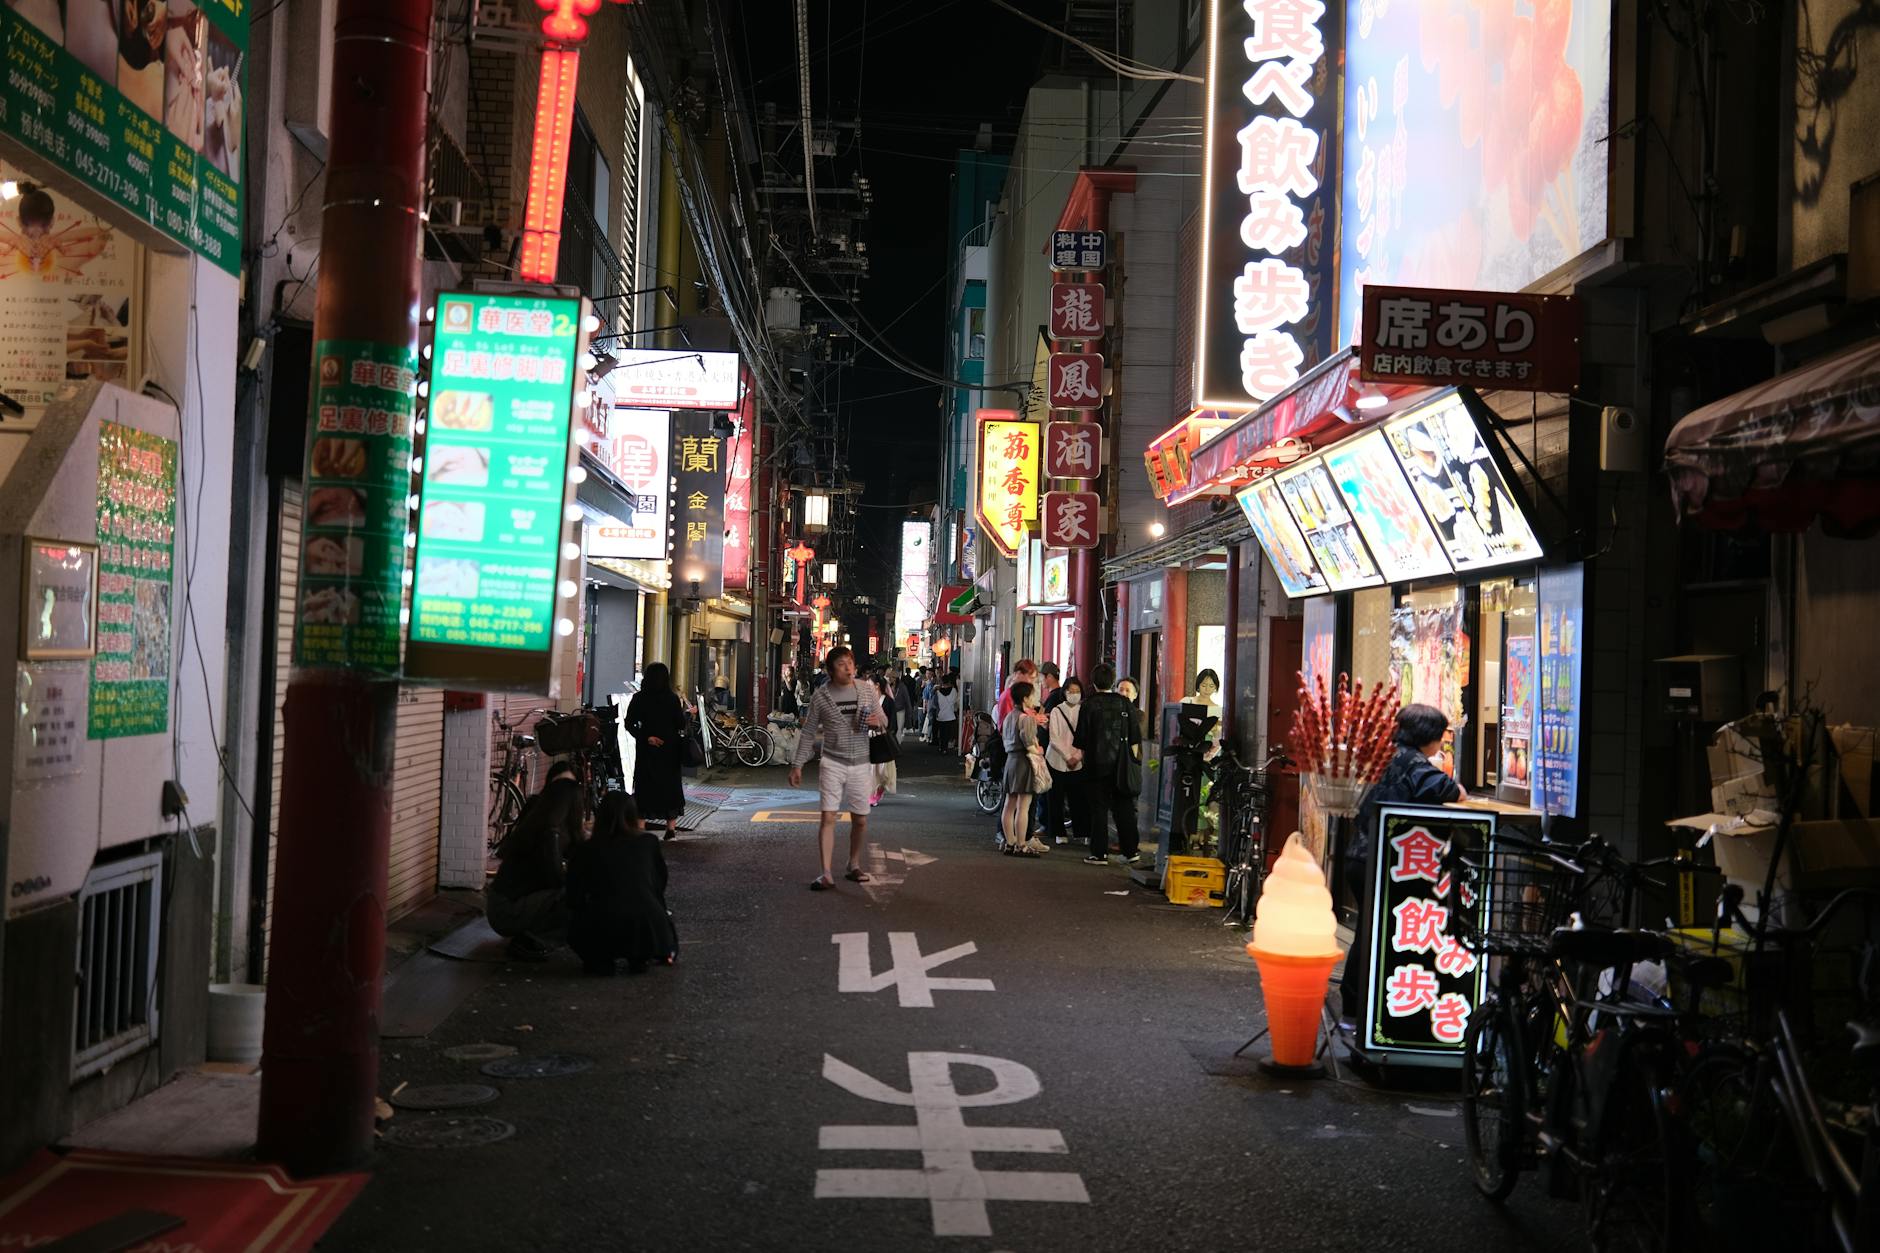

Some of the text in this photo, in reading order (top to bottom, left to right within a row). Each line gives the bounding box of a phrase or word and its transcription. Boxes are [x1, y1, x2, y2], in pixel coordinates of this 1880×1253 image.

[1234, 0, 1326, 402] 食べ飲み歩き
[1372, 352, 1533, 380] 店内飲食できます
[1375, 298, 1535, 353] 席あり
[1053, 288, 1100, 543] 龍鳳酒家
